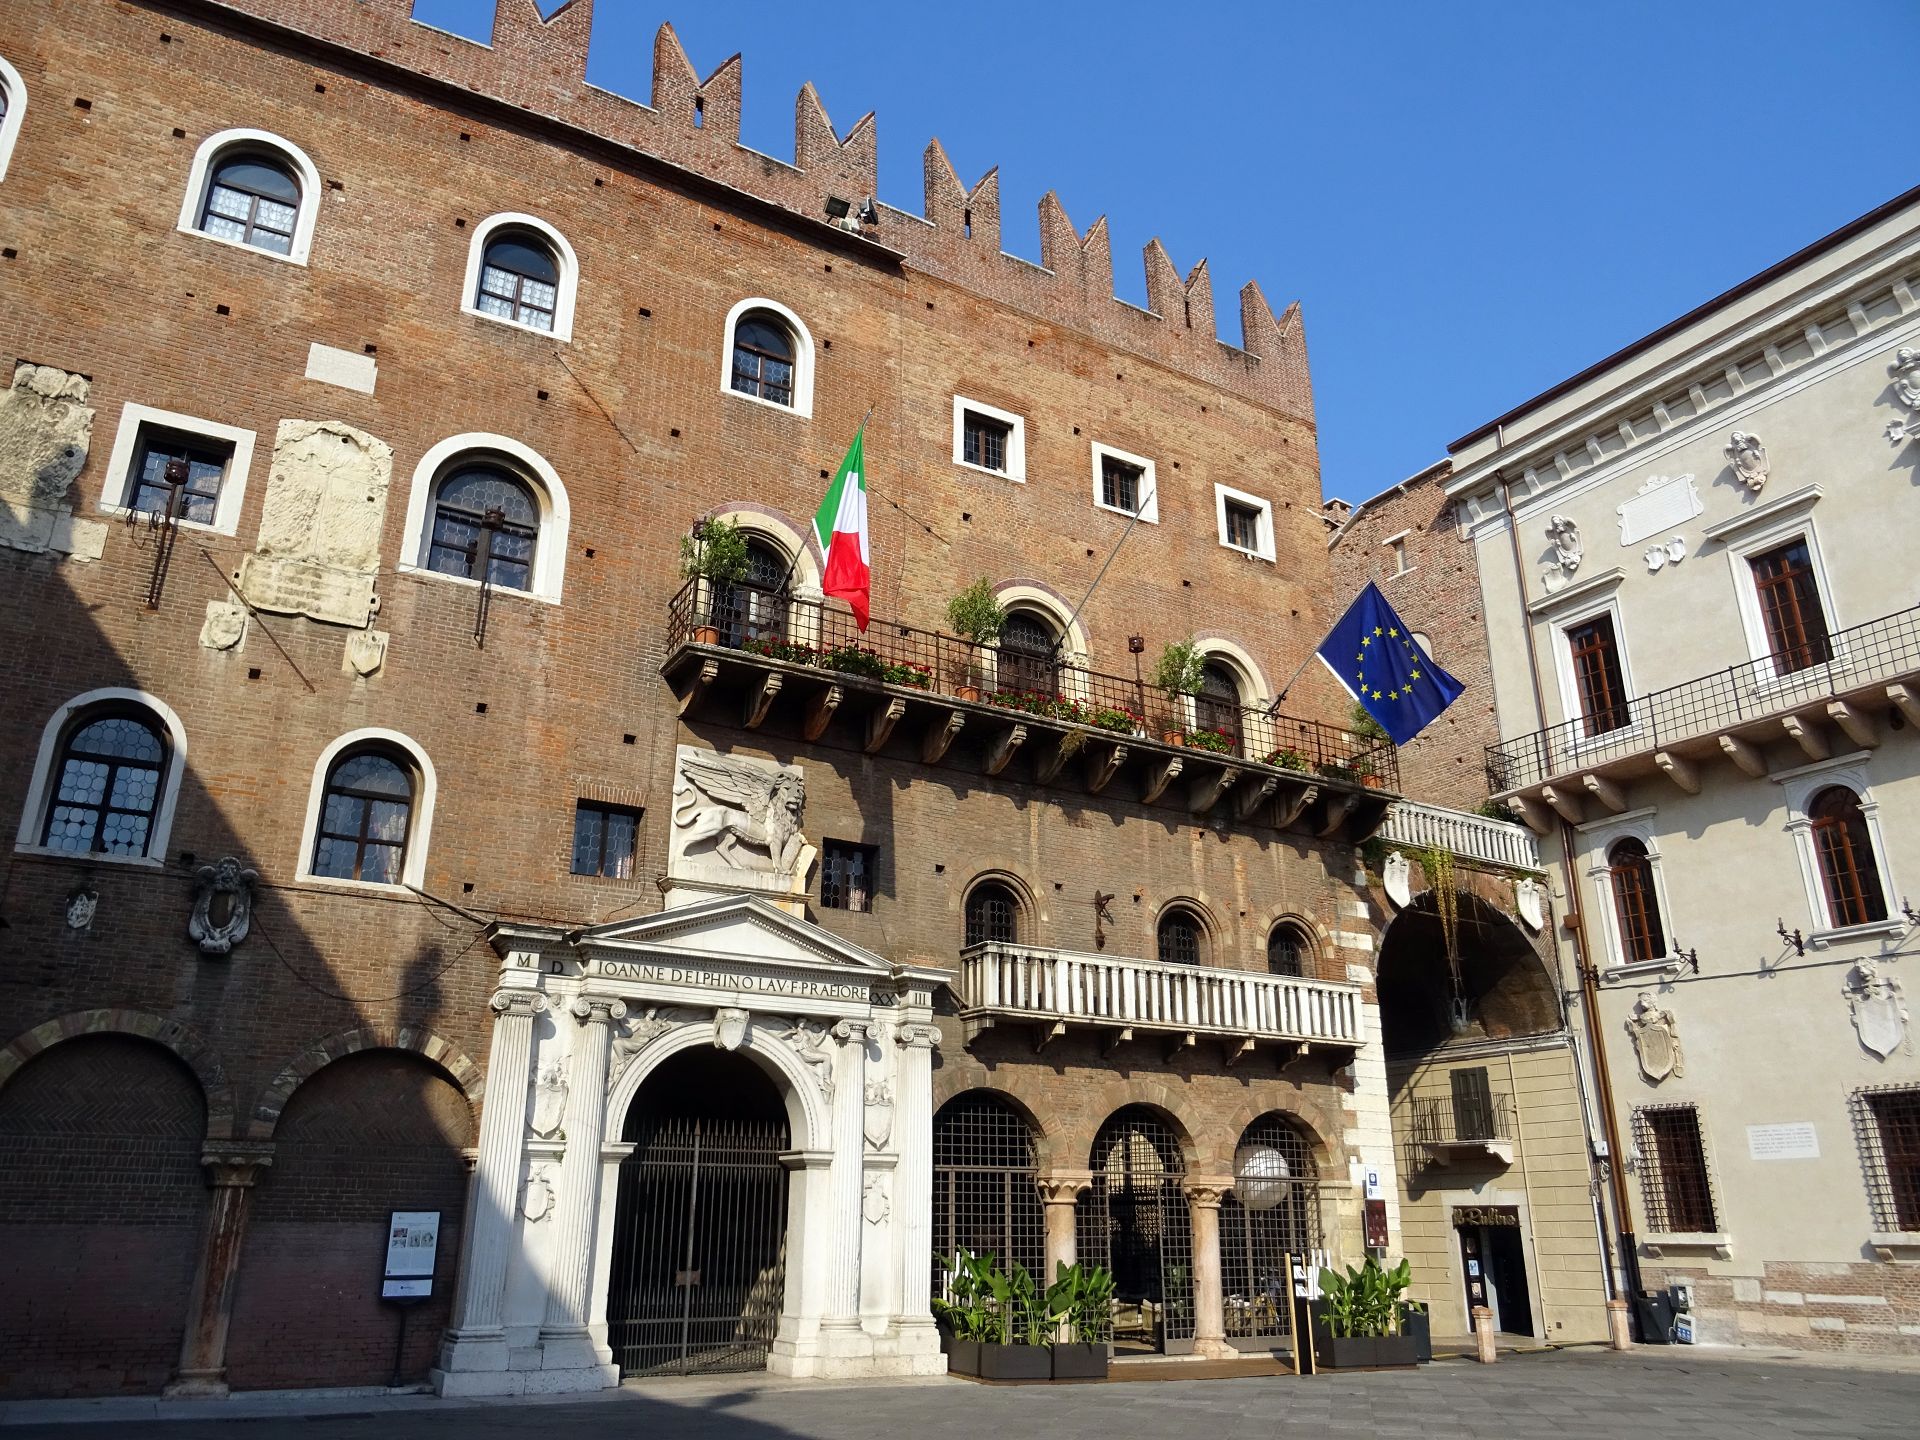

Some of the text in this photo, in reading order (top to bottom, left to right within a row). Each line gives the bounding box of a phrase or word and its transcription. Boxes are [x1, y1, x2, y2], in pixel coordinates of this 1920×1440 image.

[517, 953, 532, 968] M
[551, 960, 564, 974] D
[598, 962, 665, 982] IOANNE
[671, 969, 754, 990] DELPHINO
